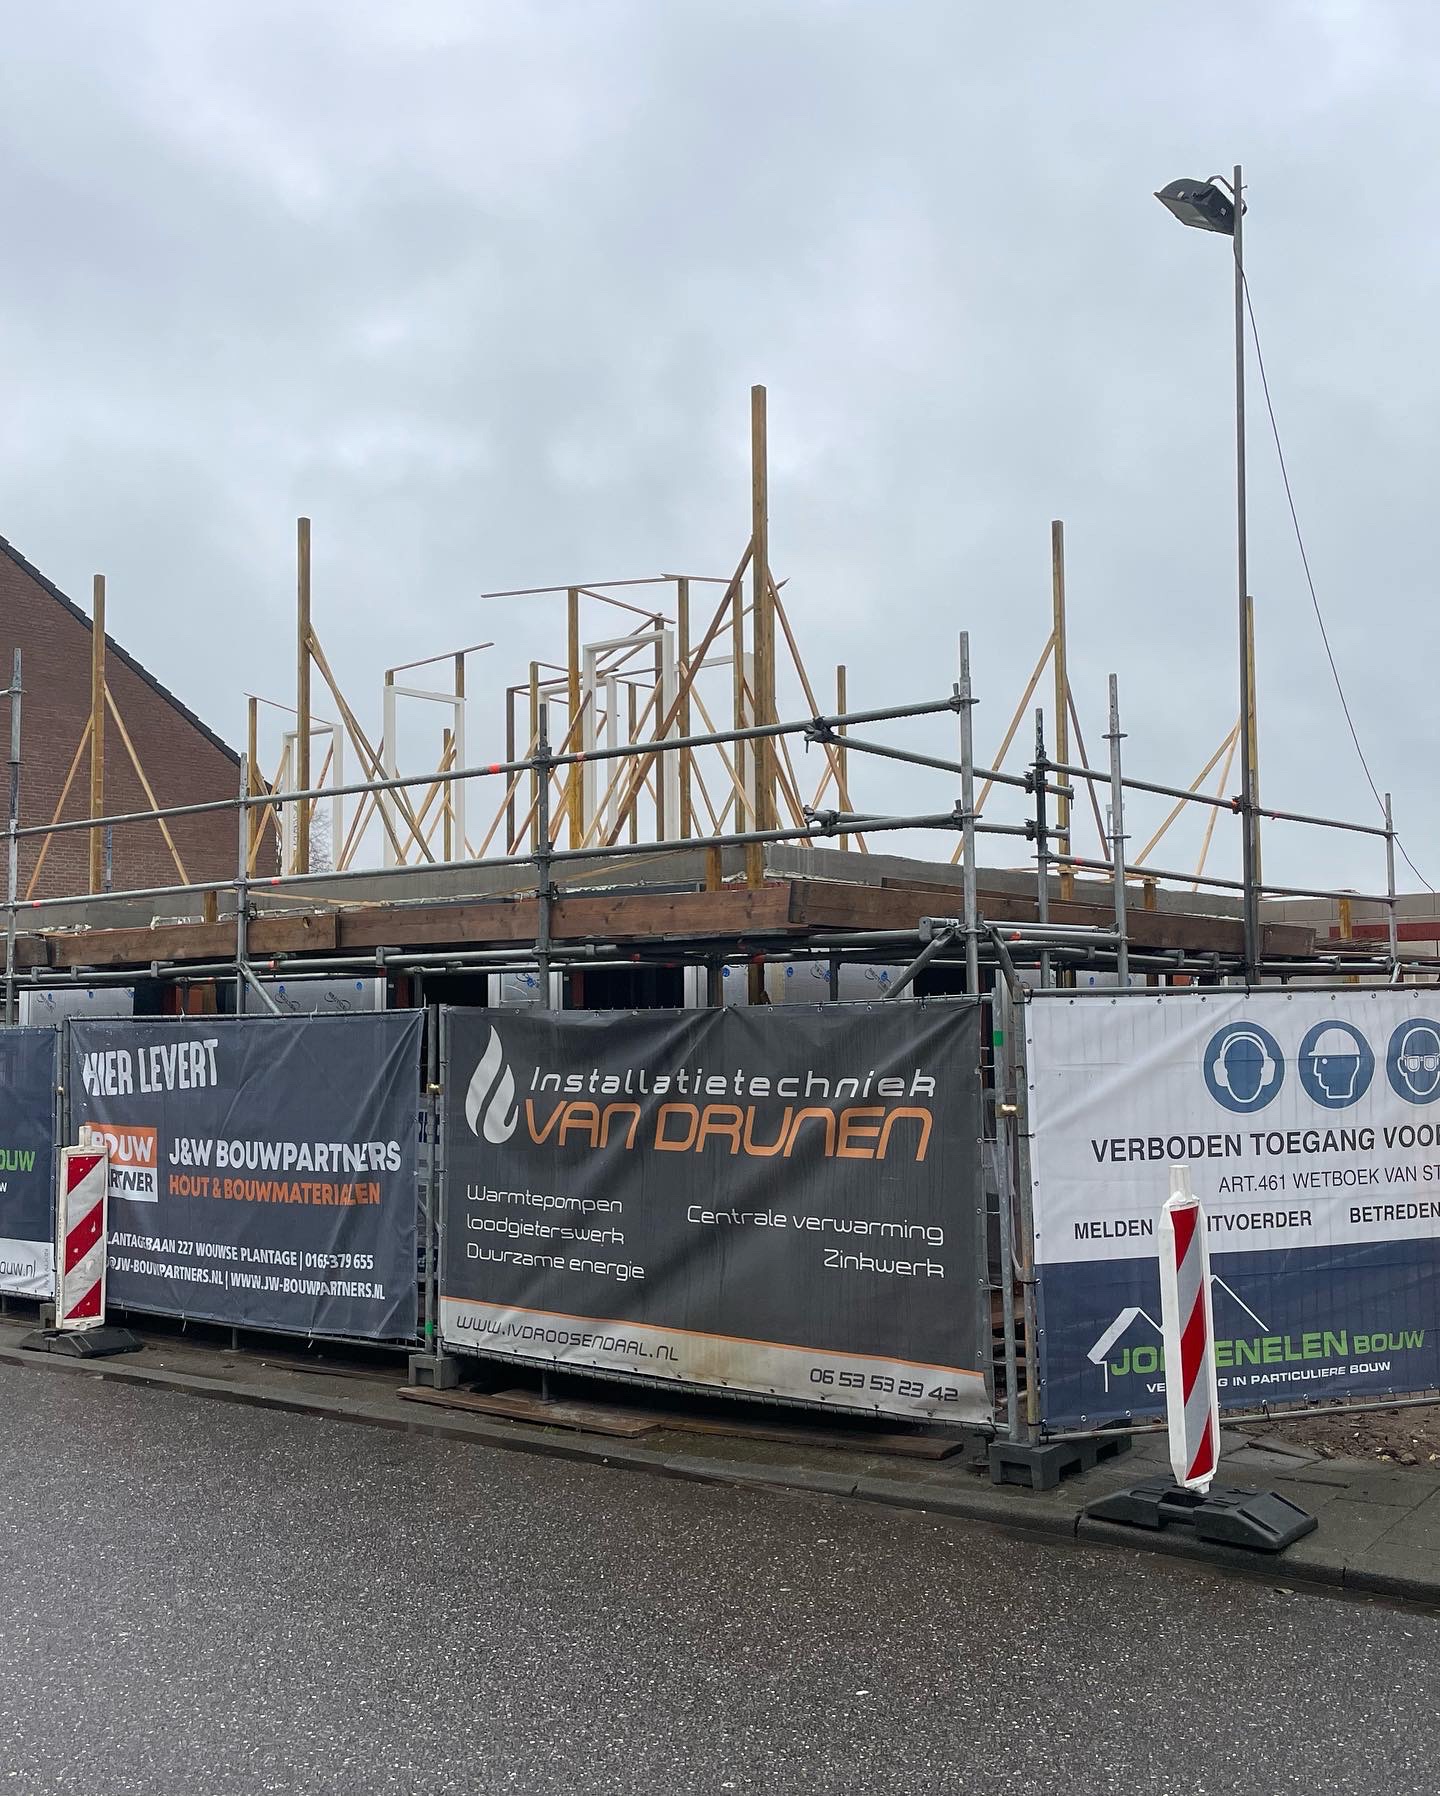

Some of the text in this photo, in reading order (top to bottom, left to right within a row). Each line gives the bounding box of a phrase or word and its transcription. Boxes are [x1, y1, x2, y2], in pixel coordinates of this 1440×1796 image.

[82, 1038, 219, 1096] HIER LEVERT
[530, 1066, 937, 1098] Installatietechniek
[525, 1098, 933, 1162] VAN DRUNEN
[1091, 1133, 1242, 1162] VERBODEN
[1250, 1127, 1375, 1156] TOEGANG
[0, 1150, 35, 1172] OUW
[169, 1137, 401, 1172] J&W BOUWPARTNERS
[108, 1168, 154, 1192] RTNER
[169, 1173, 381, 1206] HOUT & BOUWMATERIALEN
[1218, 1164, 1440, 1193] ART.461 WETBOEK VAN ST
[467, 1184, 623, 1215] Warmtepompen
[1349, 1202, 1440, 1224] BETREDEN
[467, 1213, 624, 1245] loodgieterswerk
[687, 1205, 944, 1246] Centrale verwarming
[1074, 1209, 1312, 1240] MELDEN ITVOERDER
[0, 1259, 36, 1278] ouw.nl
[107, 1256, 223, 1285] @JW-BOUWPARTNERS.NL
[177, 1240, 193, 1256] 227
[196, 1242, 238, 1261] WOUWSE
[240, 1247, 297, 1266] PLANTAGE
[353, 1253, 374, 1270] 655
[466, 1242, 645, 1282] Duurzame energie
[823, 1248, 944, 1278] Zinkwerk
[456, 1315, 679, 1361] WWW.IVDROOSENDAAL.NL
[1353, 1330, 1425, 1354] BOUW
[810, 1368, 959, 1402] 06 53 53 23 42
[1232, 1375, 1247, 1387] IN
[1250, 1366, 1346, 1385] PARTICULIERE
[1349, 1361, 1391, 1375] BOUW
